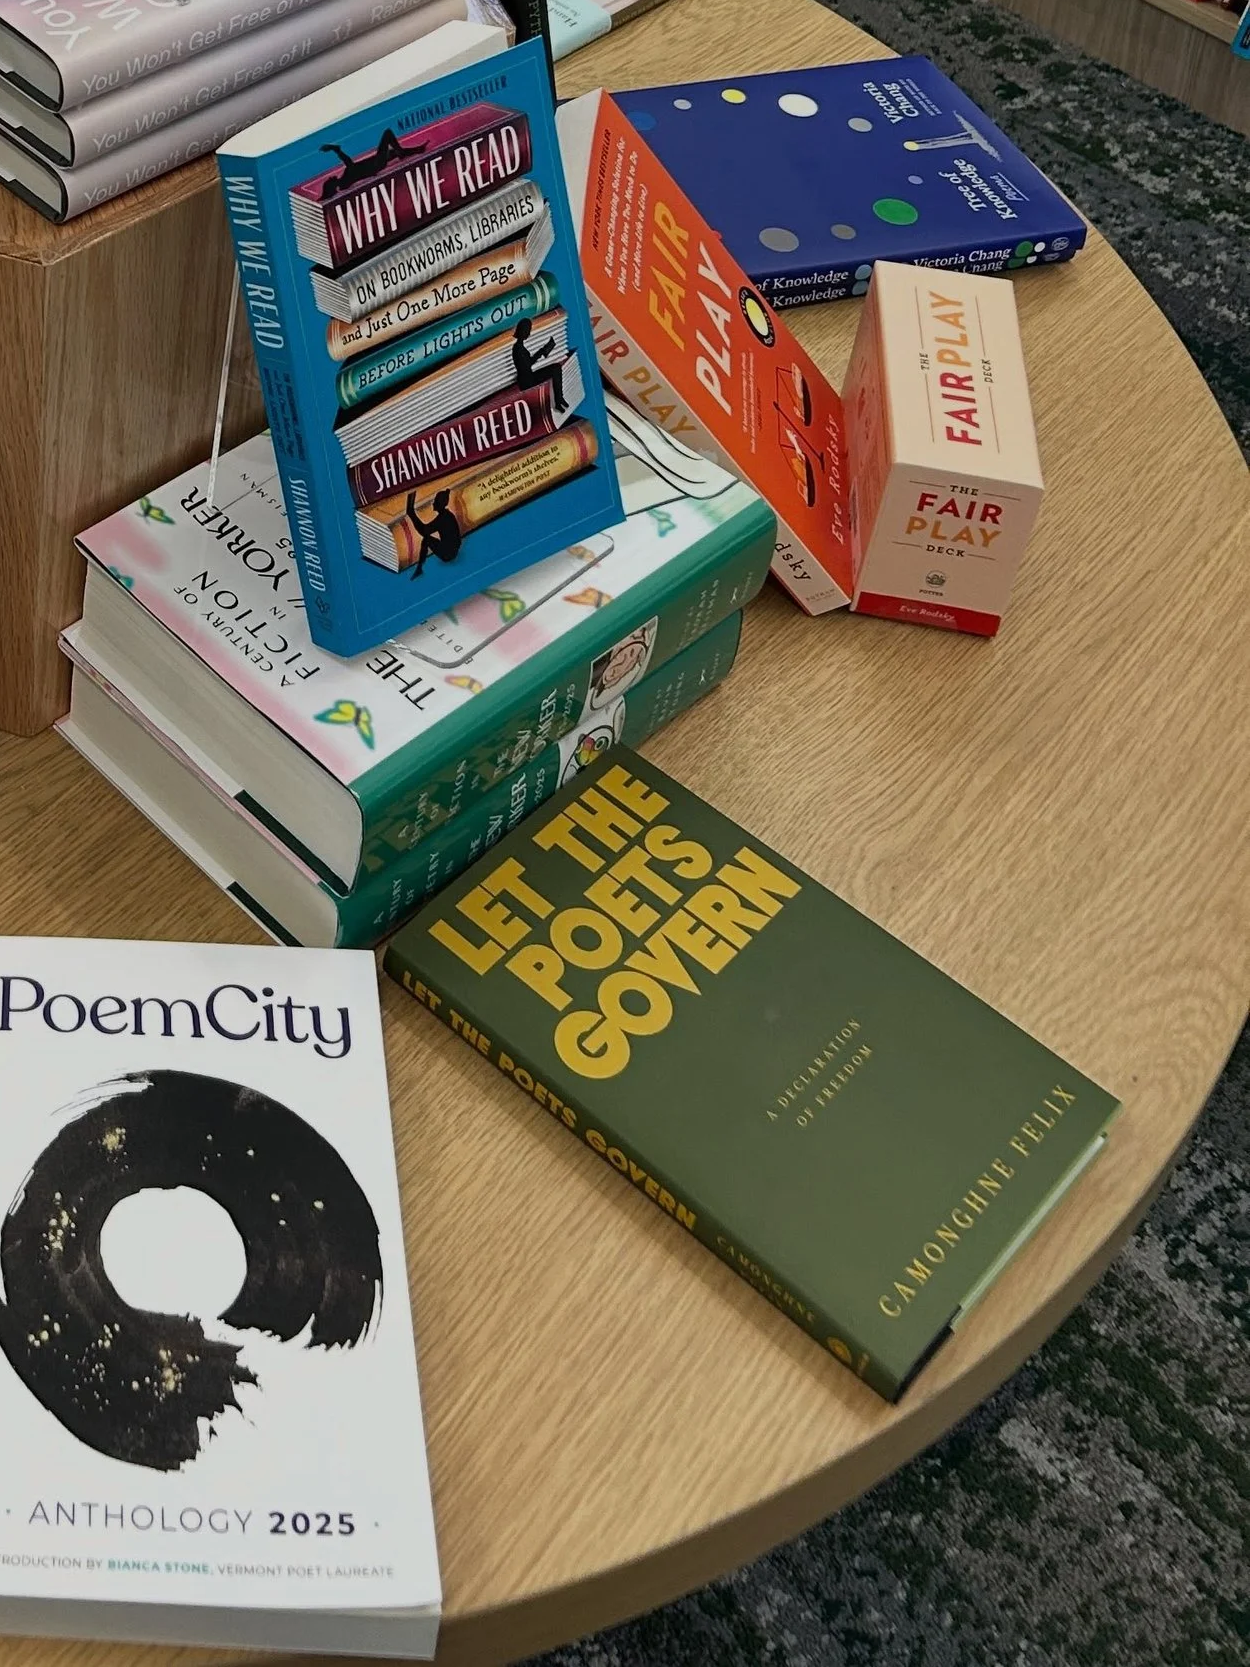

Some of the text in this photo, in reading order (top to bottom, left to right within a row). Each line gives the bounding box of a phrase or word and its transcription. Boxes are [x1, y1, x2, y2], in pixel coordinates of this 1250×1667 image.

[862, 81, 905, 125] Victoria
[882, 82, 920, 119] Chang
[224, 173, 259, 232] WHY
[334, 125, 523, 256] WHY WE READ
[952, 157, 1020, 221] Knowledge
[242, 237, 273, 286] WE
[355, 195, 536, 306] ON BOOKWORMS, LIBRARIES
[647, 200, 691, 352] FAIR
[250, 289, 285, 351] READ
[340, 261, 518, 347] and Just One More Page
[356, 294, 528, 391] BEFORE LIGHTS OUT
[694, 241, 739, 416] PLAY
[928, 289, 984, 447] FAIR PLAY
[369, 400, 534, 494] SHANNON REED
[949, 484, 980, 497] THE
[180, 484, 290, 594] YORKER
[287, 475, 328, 593] SHANNON REED
[905, 515, 1002, 550] PLAY
[916, 491, 1004, 526] FAIR
[925, 543, 966, 559] DECK
[191, 568, 322, 682] FICTION
[201, 608, 276, 674] CENTURY
[365, 647, 437, 712] THE
[427, 763, 672, 977] LET THE
[504, 823, 714, 1013] POETS
[553, 844, 803, 1080] GOVERN
[765, 1016, 863, 1123] A DECLARATION
[795, 1042, 874, 1130] OF FREEDOM
[878, 1083, 1077, 1319] CAMONGHNE FELIX
[28, 1500, 358, 1538] ANTHOLOGY 2025
